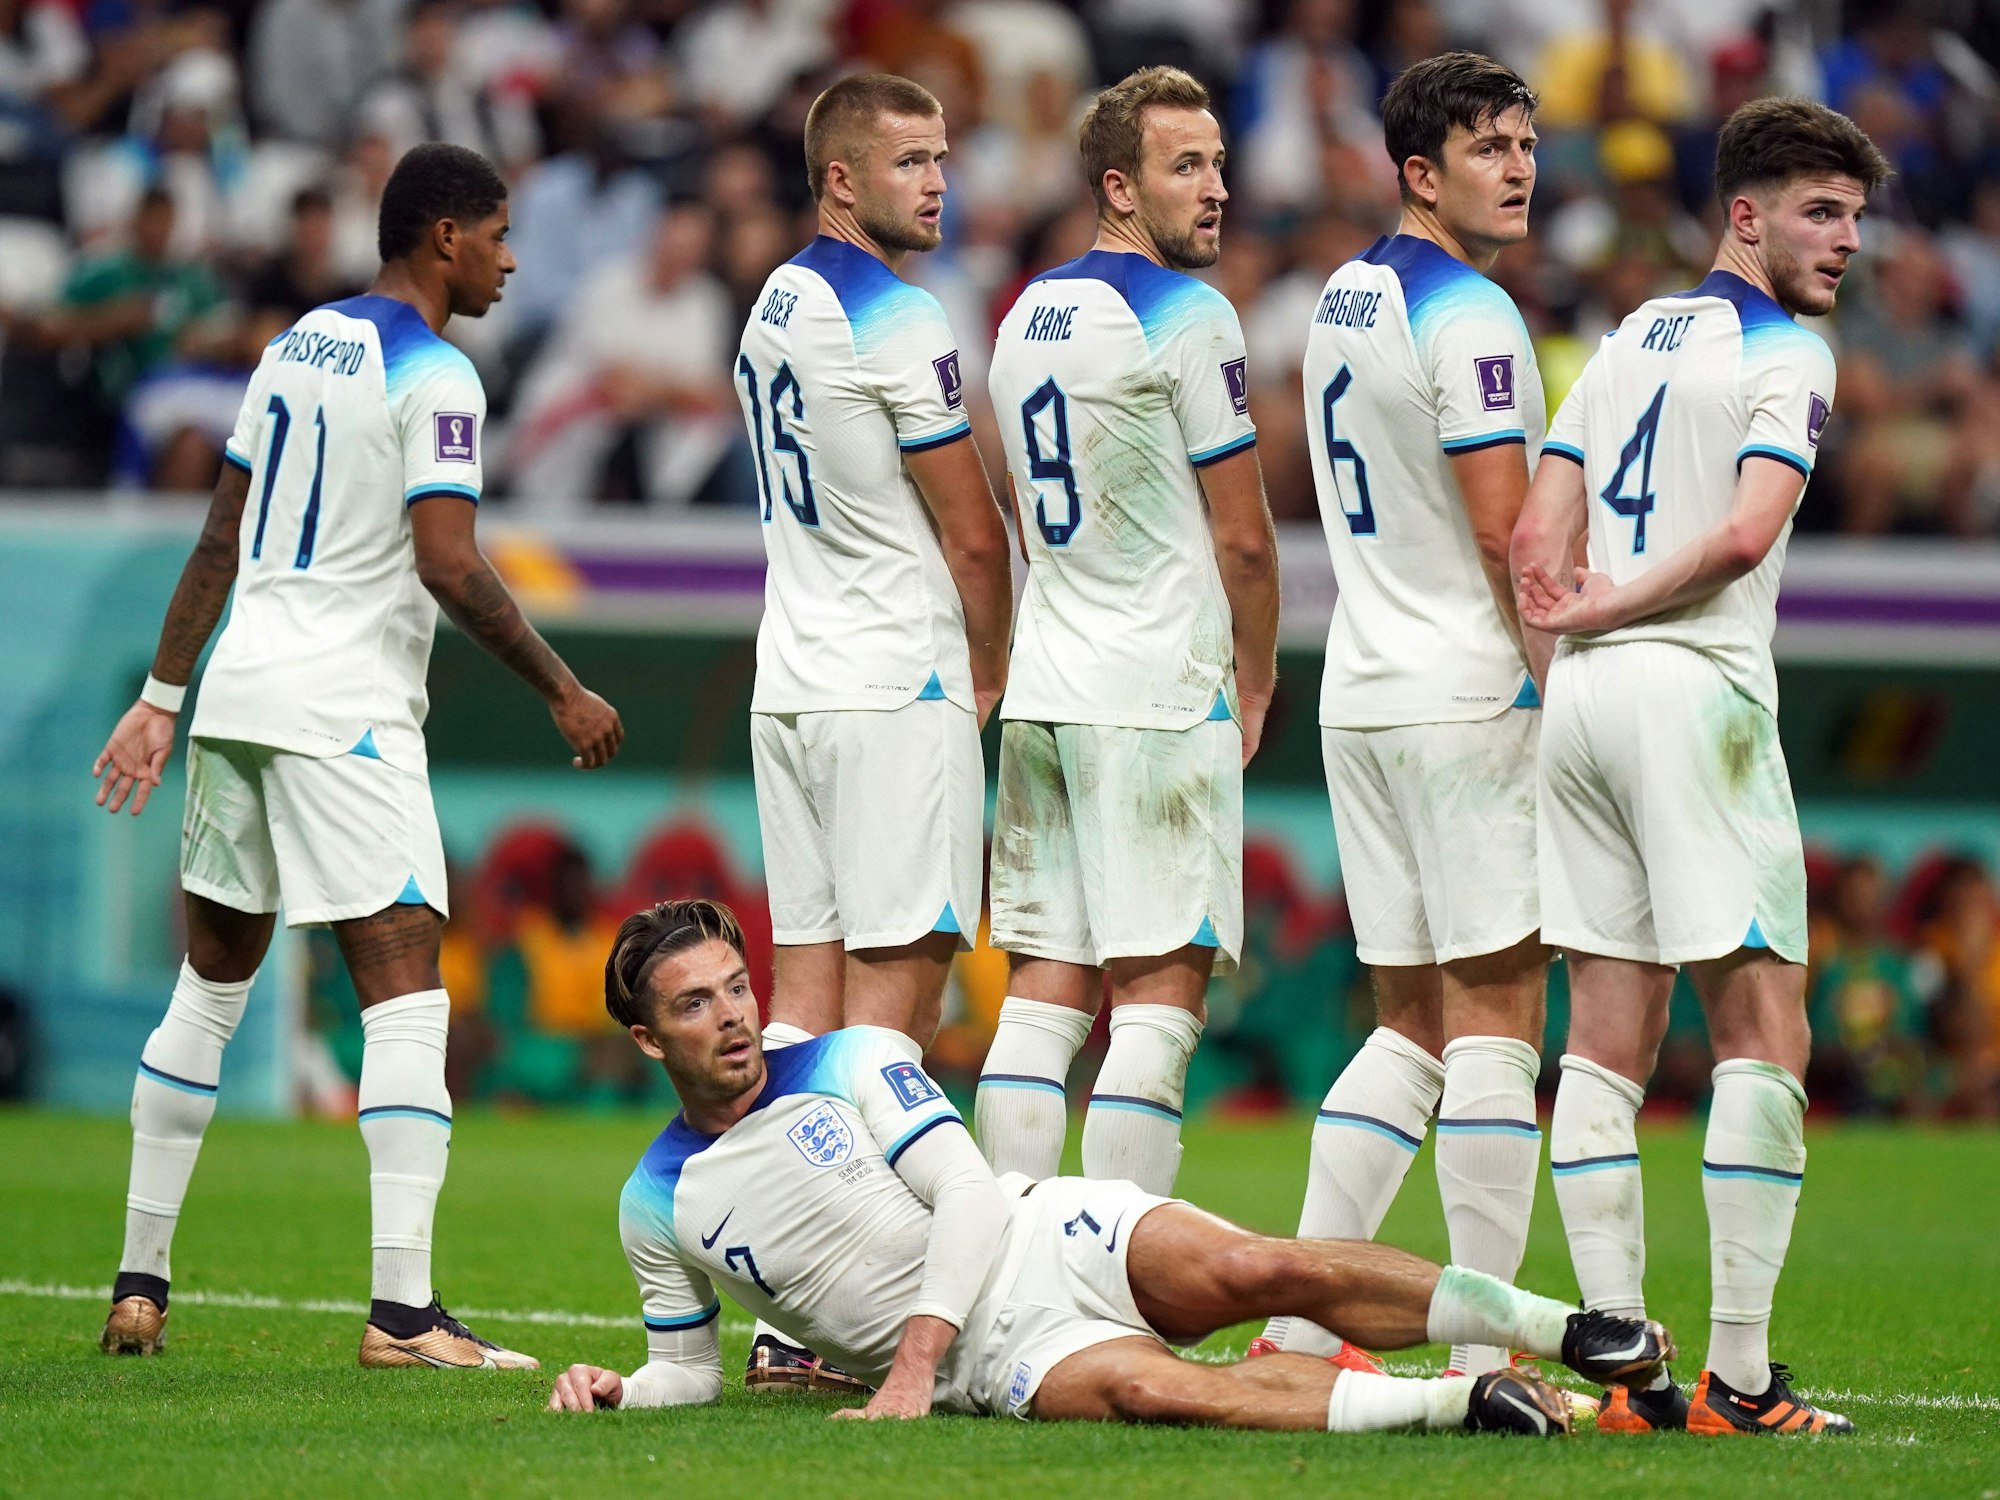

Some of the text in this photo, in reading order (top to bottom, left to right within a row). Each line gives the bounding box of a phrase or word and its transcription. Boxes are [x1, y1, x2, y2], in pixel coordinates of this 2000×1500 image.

[761, 288, 798, 328] DIER
[1024, 306, 1079, 341] KANE
[1315, 287, 1383, 328] MAGUIRE
[739, 353, 820, 528] 15
[1021, 374, 1082, 547] 9
[1322, 362, 1377, 538] 6
[251, 394, 327, 570] 11
[1600, 381, 1668, 555] 4
[838, 1158, 867, 1180] SENEGAL
[1064, 1209, 1102, 1237] 7
[724, 1246, 777, 1298] 7
